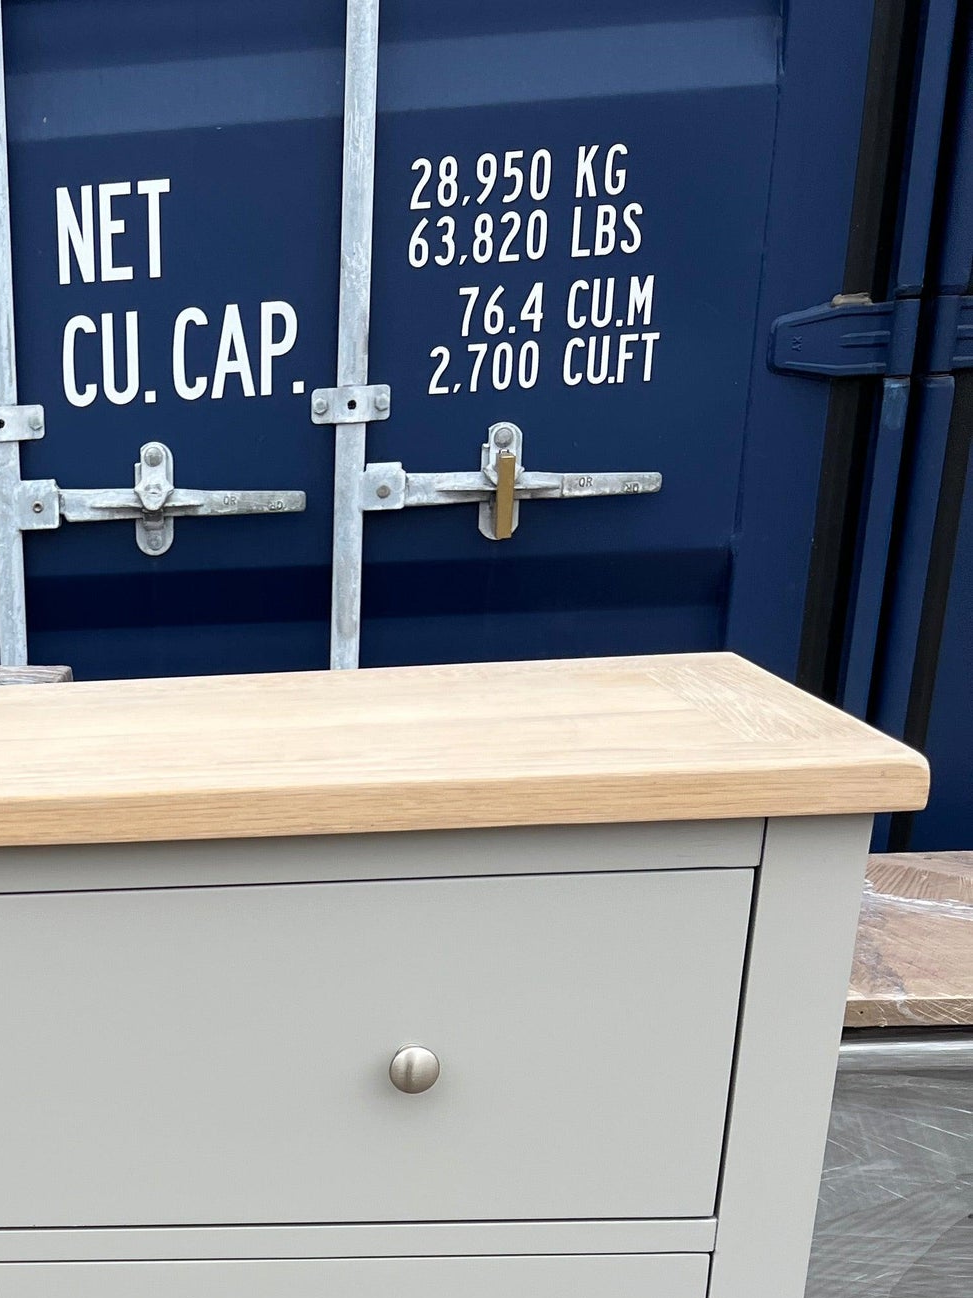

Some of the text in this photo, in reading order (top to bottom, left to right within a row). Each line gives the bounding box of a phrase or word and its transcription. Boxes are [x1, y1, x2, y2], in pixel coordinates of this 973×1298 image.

[410, 143, 628, 210] 28,950 KG
[56, 178, 170, 285] NET
[407, 202, 643, 268] 63,820 LBS
[459, 274, 655, 337] 76.4 CU.M
[62, 300, 305, 408] CU. CAP.
[428, 332, 661, 395] 2,700 CU.FT
